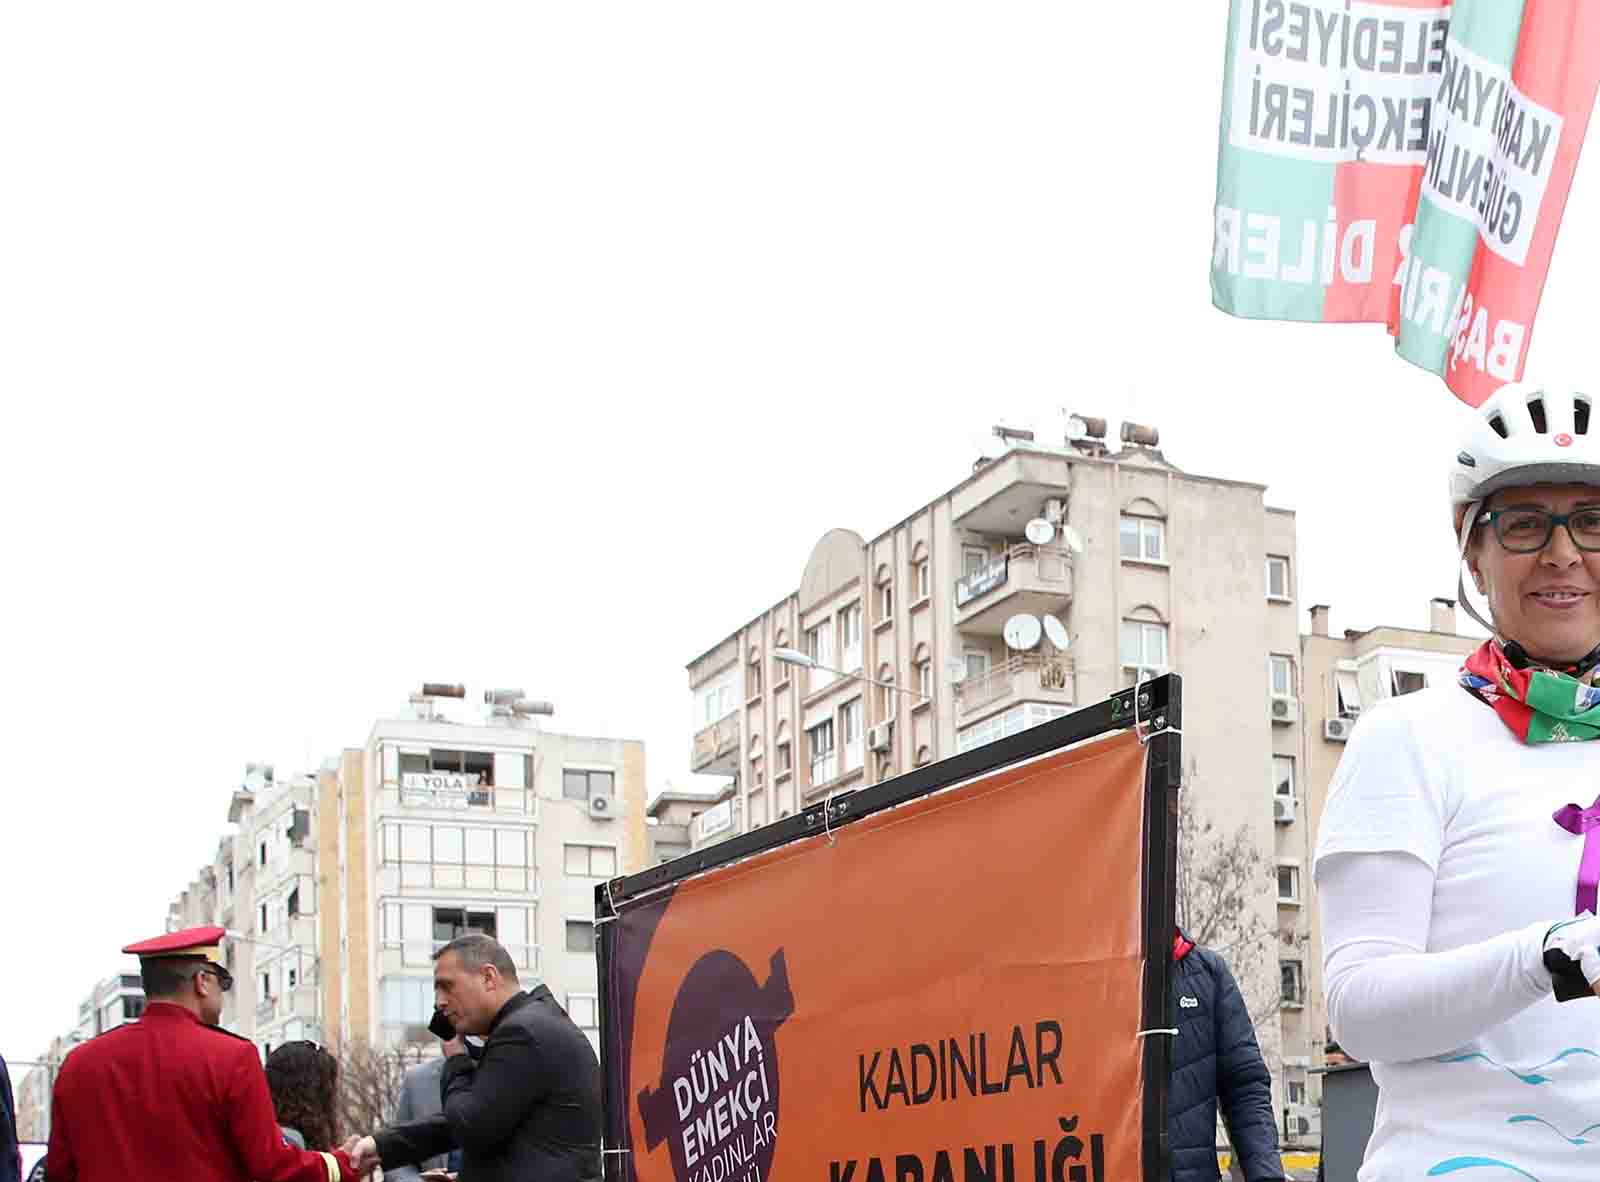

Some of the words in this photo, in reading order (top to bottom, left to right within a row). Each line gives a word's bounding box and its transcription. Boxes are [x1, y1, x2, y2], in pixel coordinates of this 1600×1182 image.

[673, 1015, 762, 1121] DÜNYA
[682, 1053, 769, 1168] EMEKÇİ
[857, 1020, 1064, 1112] KADINLAR
